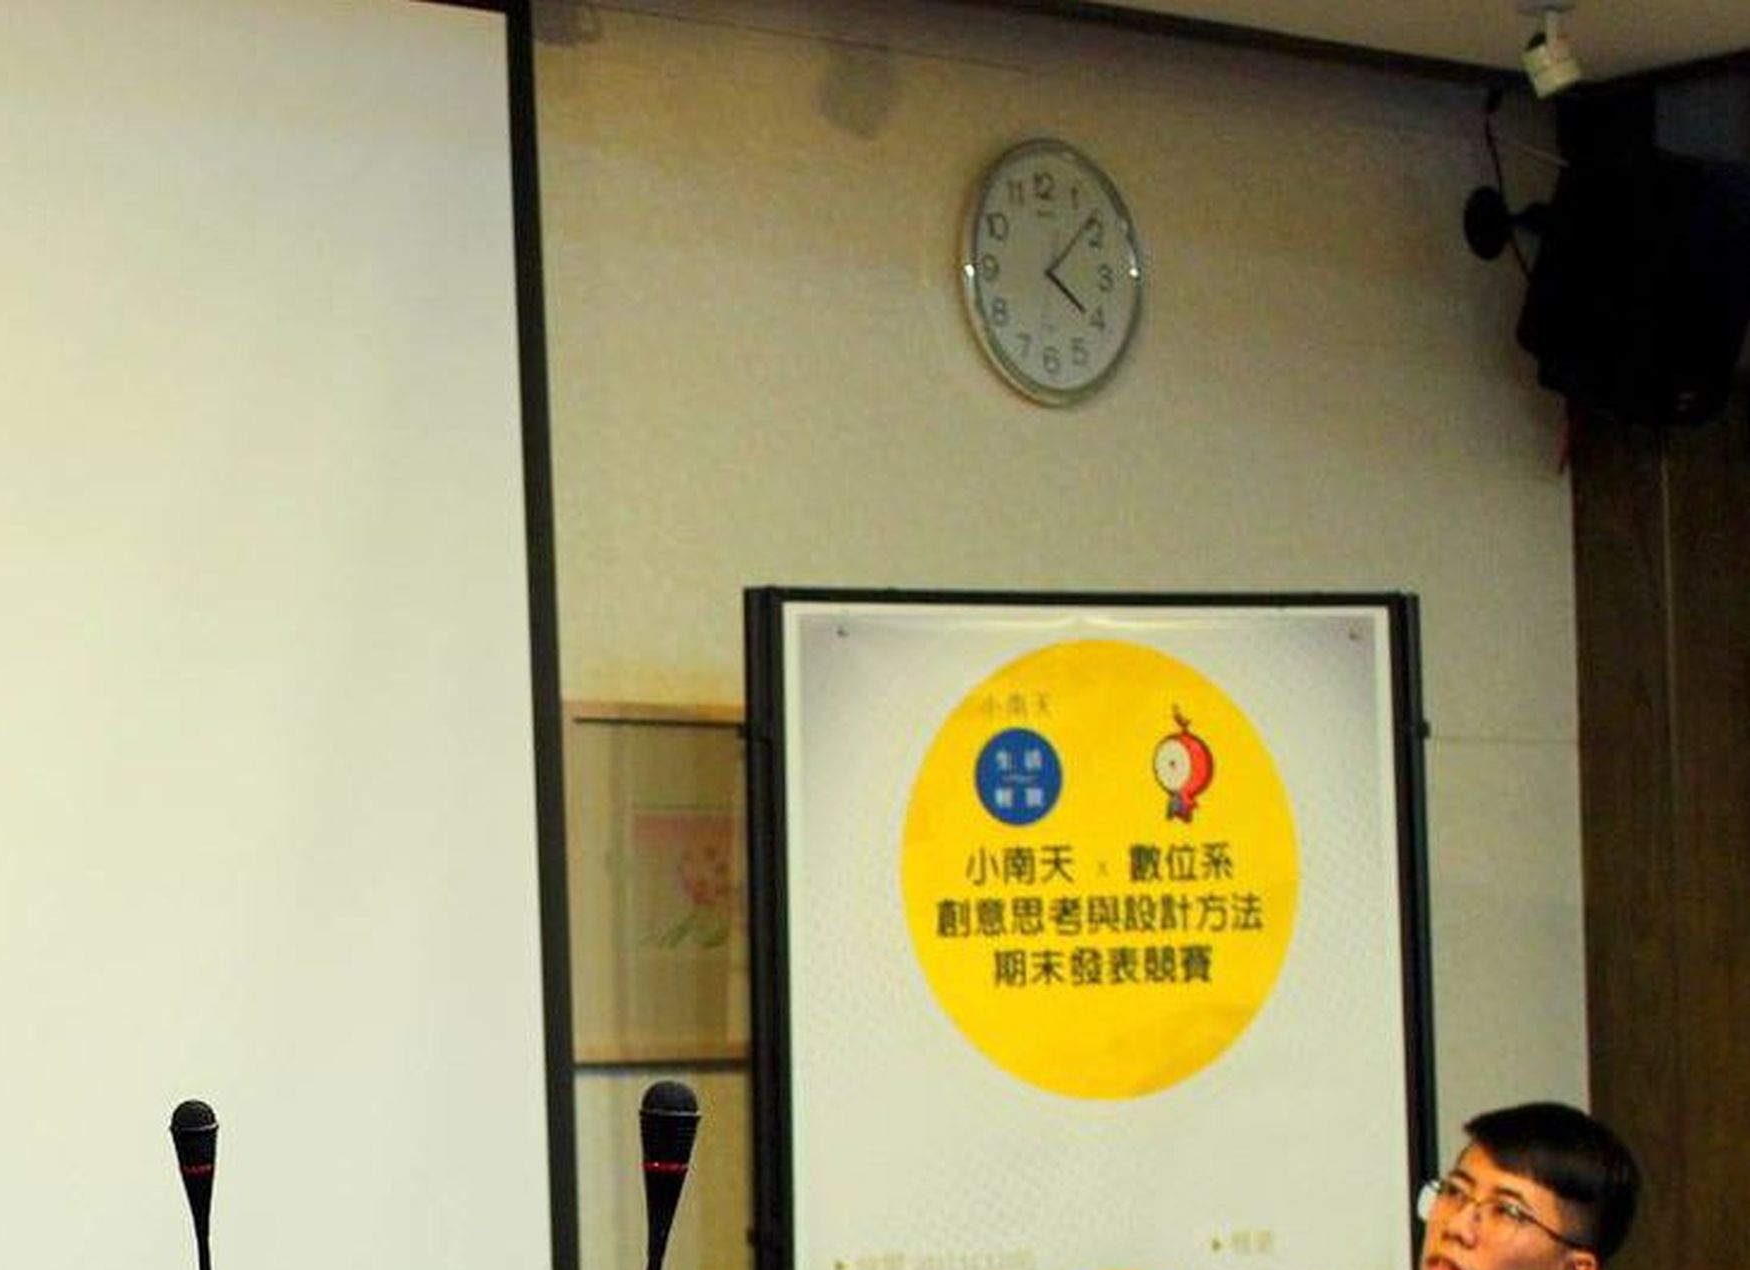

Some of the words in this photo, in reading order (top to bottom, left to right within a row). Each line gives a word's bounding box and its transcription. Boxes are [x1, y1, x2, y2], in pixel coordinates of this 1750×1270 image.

[1008, 181, 1025, 207] 11
[1034, 171, 1054, 203] 12
[987, 211, 1009, 242] 10
[980, 253, 999, 282] 9
[1100, 263, 1115, 292] 3
[991, 298, 1008, 327] 8
[1089, 307, 1105, 332] 4
[1016, 332, 1032, 359] 7
[1043, 346, 1061, 374] 6
[1071, 337, 1089, 366] 5
[966, 845, 1074, 886] 小南天
[1129, 842, 1233, 883] 數位系
[937, 892, 1263, 938] 創意思考與設計方法
[994, 944, 1212, 987] 期末發表競賽
